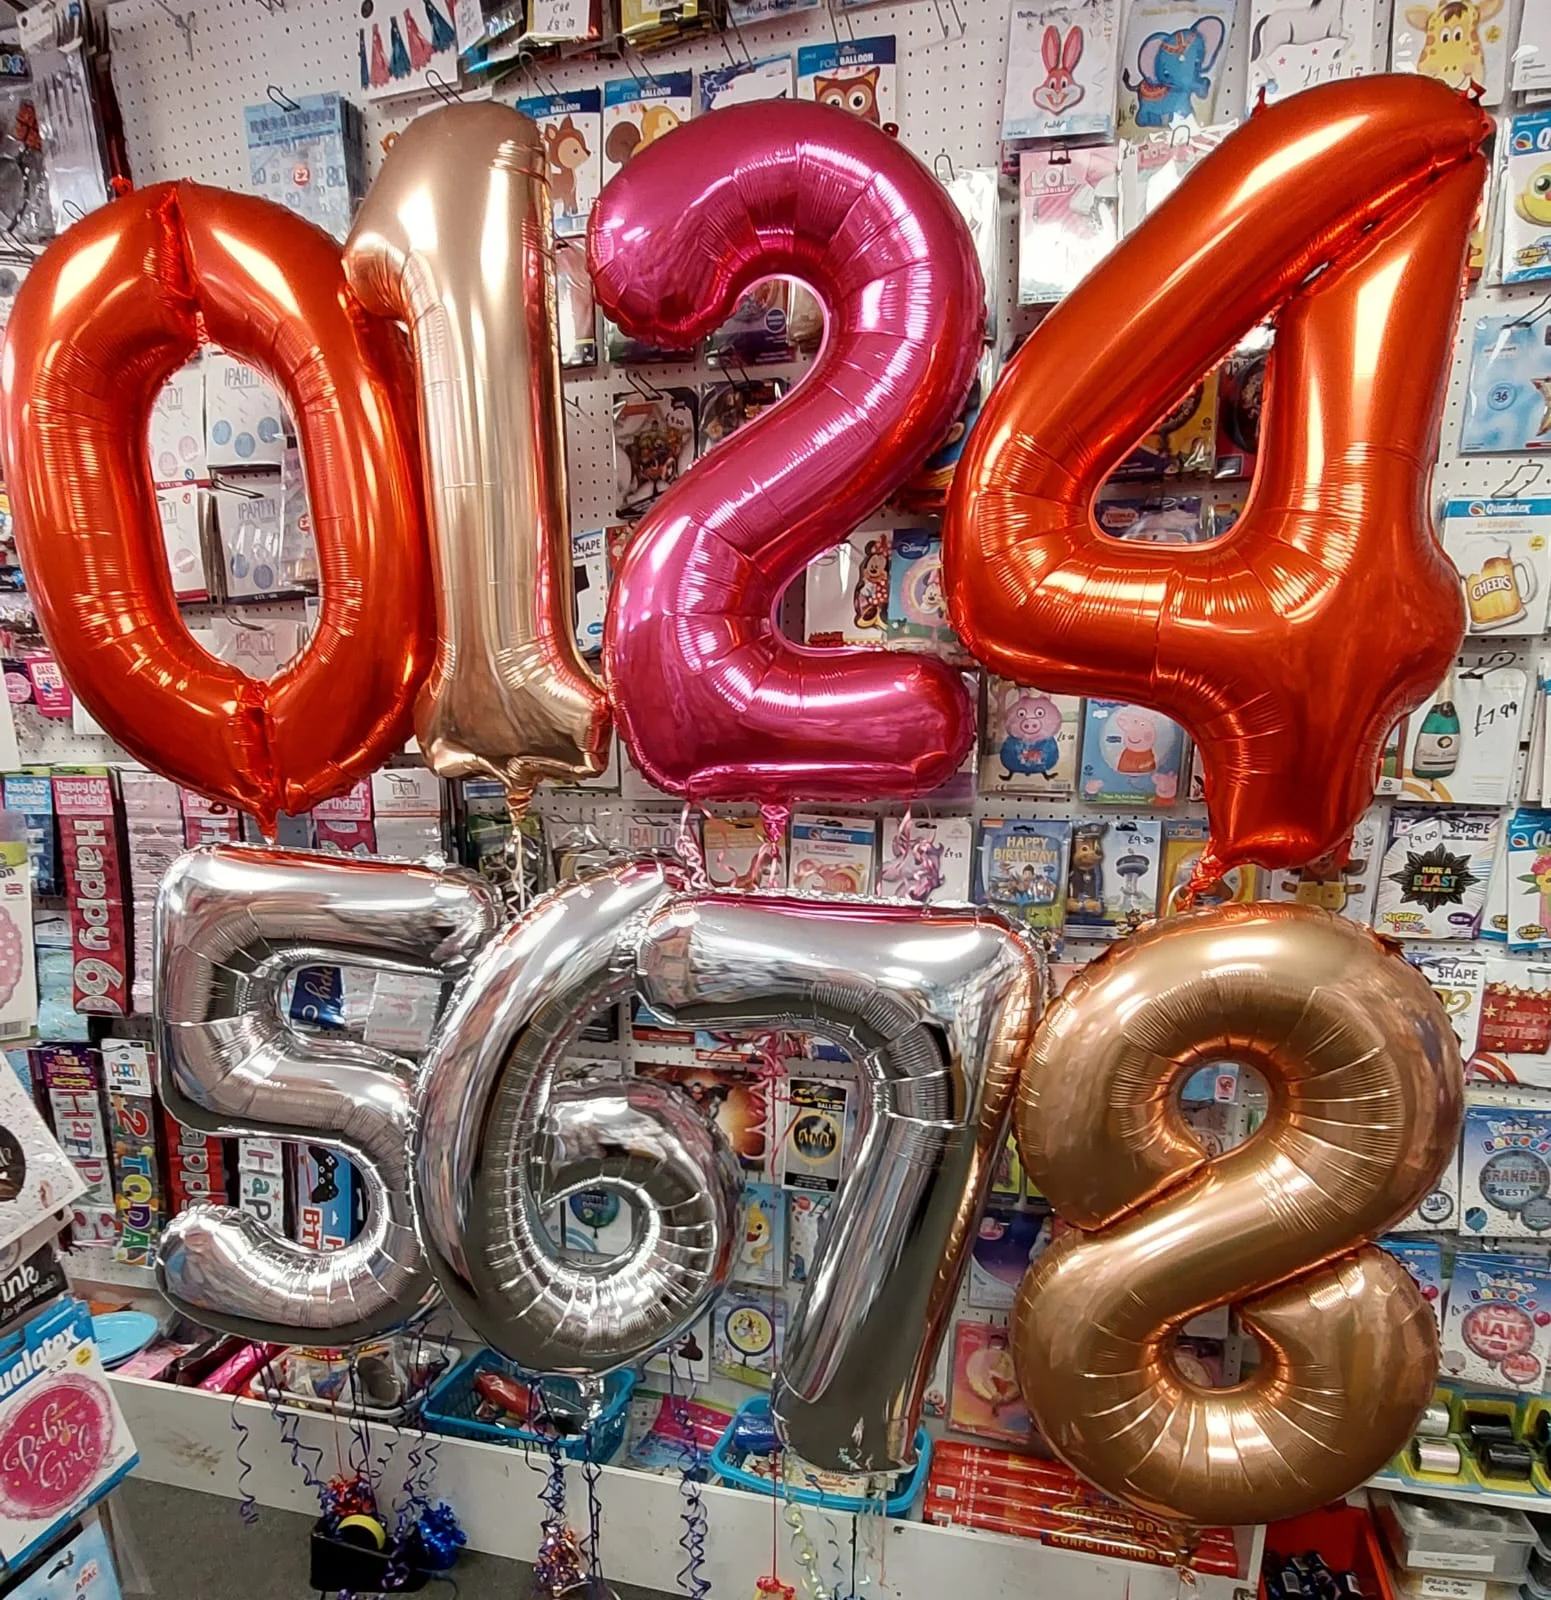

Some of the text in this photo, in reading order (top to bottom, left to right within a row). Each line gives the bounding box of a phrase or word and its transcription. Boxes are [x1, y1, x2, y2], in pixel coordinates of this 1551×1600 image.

[839, 52, 874, 65] BALLOON
[640, 86, 672, 97] BALLOON
[550, 102, 582, 114] BALLOON
[1030, 165, 1077, 190] LOL
[1494, 389, 1510, 402] 36
[901, 542, 929, 553] Disney
[1471, 574, 1513, 601] CHEERS
[56, 780, 88, 794] Happy
[1448, 820, 1491, 835] SHAPE
[1006, 836, 1049, 848] HAPPY
[992, 849, 1058, 864] BIRTHDAY!
[1421, 866, 1452, 874] HAVE A
[72, 820, 111, 951] Happy
[1413, 874, 1459, 887] BLAST
[1437, 966, 1478, 980] SHAPE
[111, 1062, 144, 1078] PARTY
[1471, 1318, 1526, 1342] NAN
[3, 1403, 78, 1480] Baby
